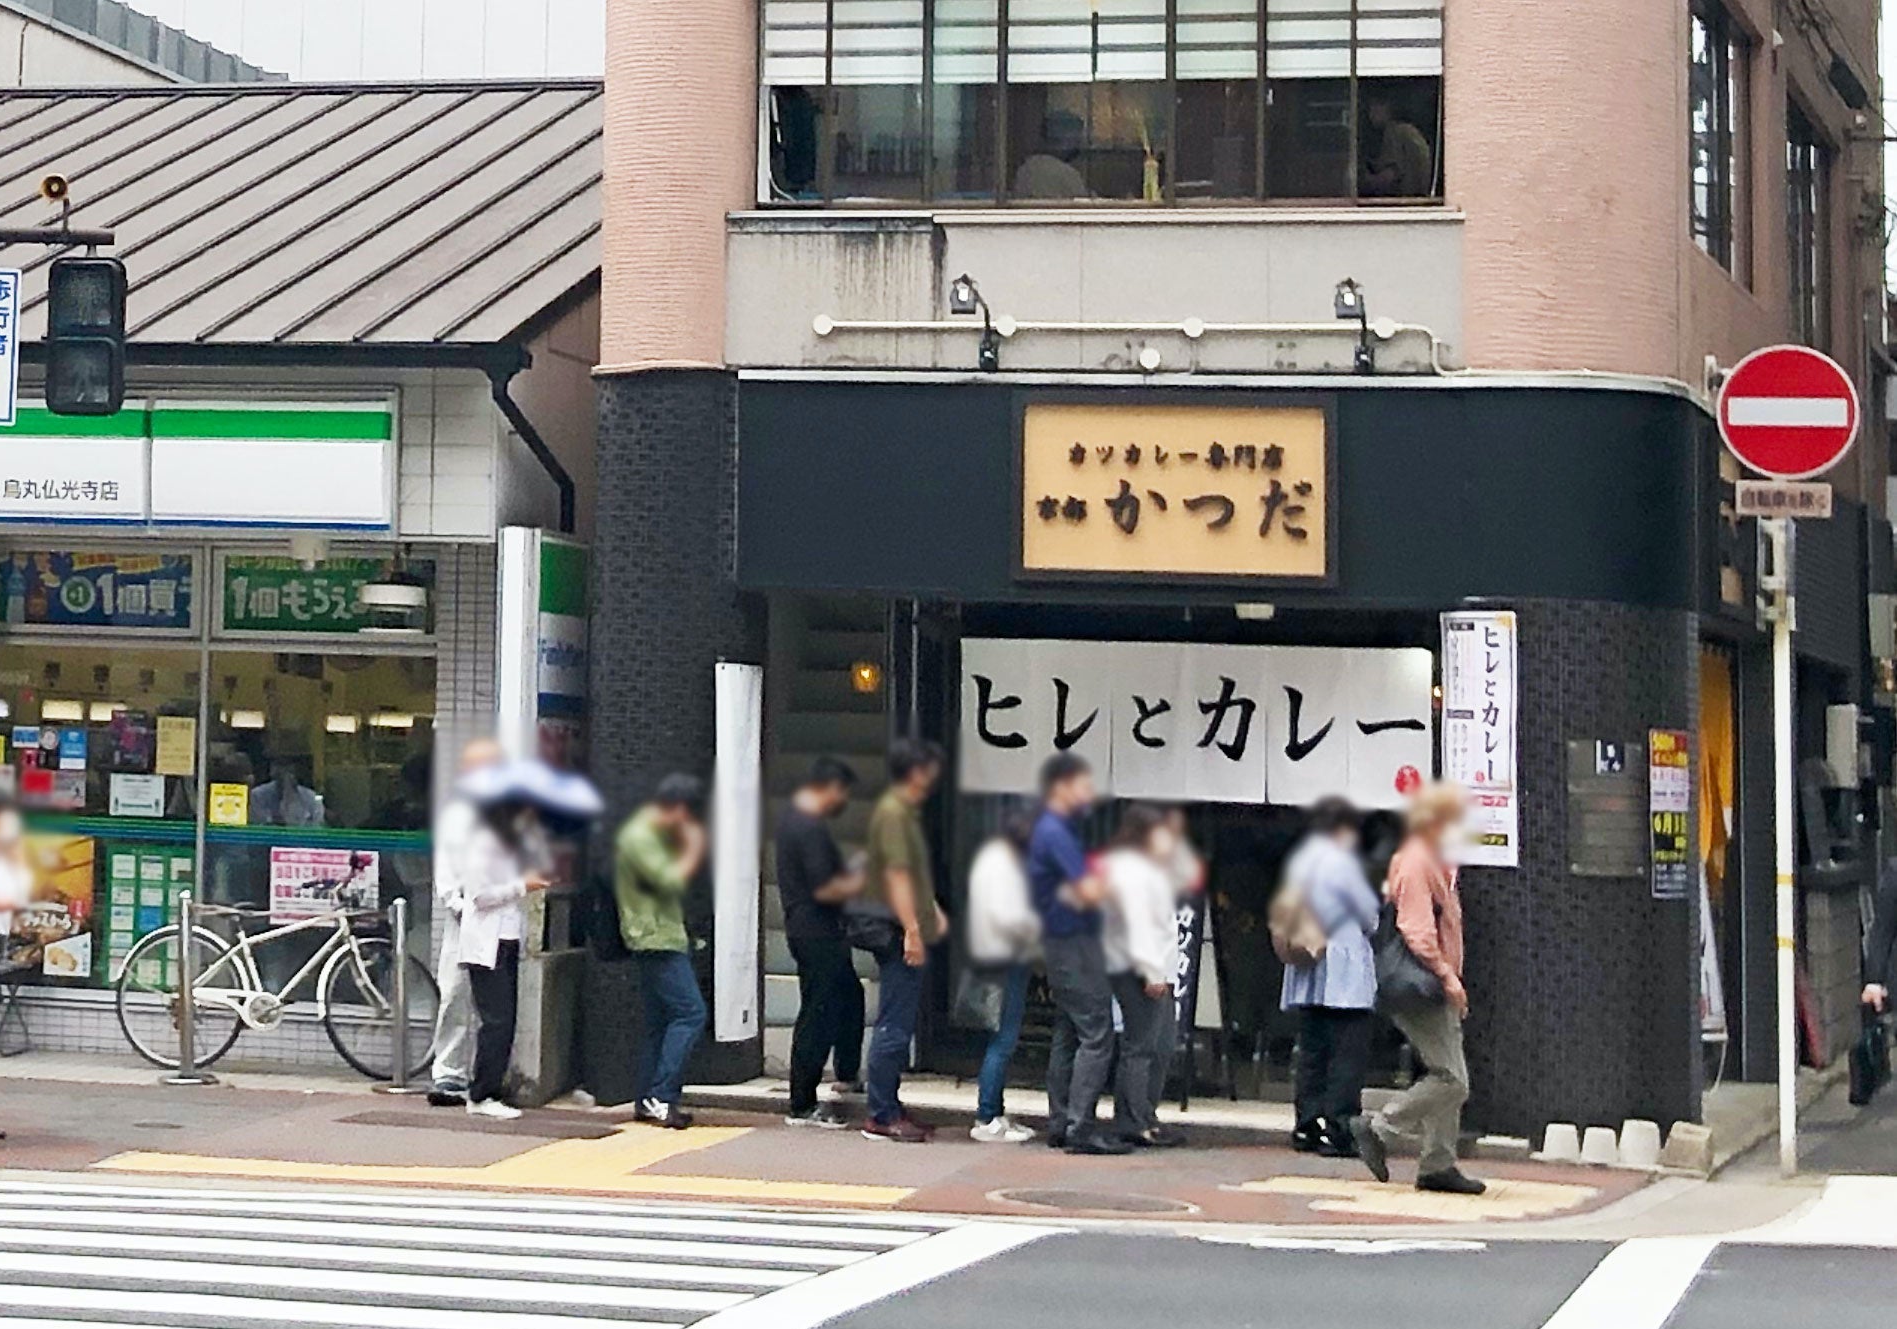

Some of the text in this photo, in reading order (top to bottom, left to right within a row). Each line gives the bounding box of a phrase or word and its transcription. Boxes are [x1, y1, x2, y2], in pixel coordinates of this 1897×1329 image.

[1068, 440, 1285, 472] カツカレー専門店
[1, 478, 120, 501] 烏丸仏光寺店
[1103, 478, 1313, 538] かつだ
[96, 573, 191, 618] 1個買
[971, 673, 1427, 763] ヒレとカレー
[1482, 625, 1501, 783] ヒレとカレー
